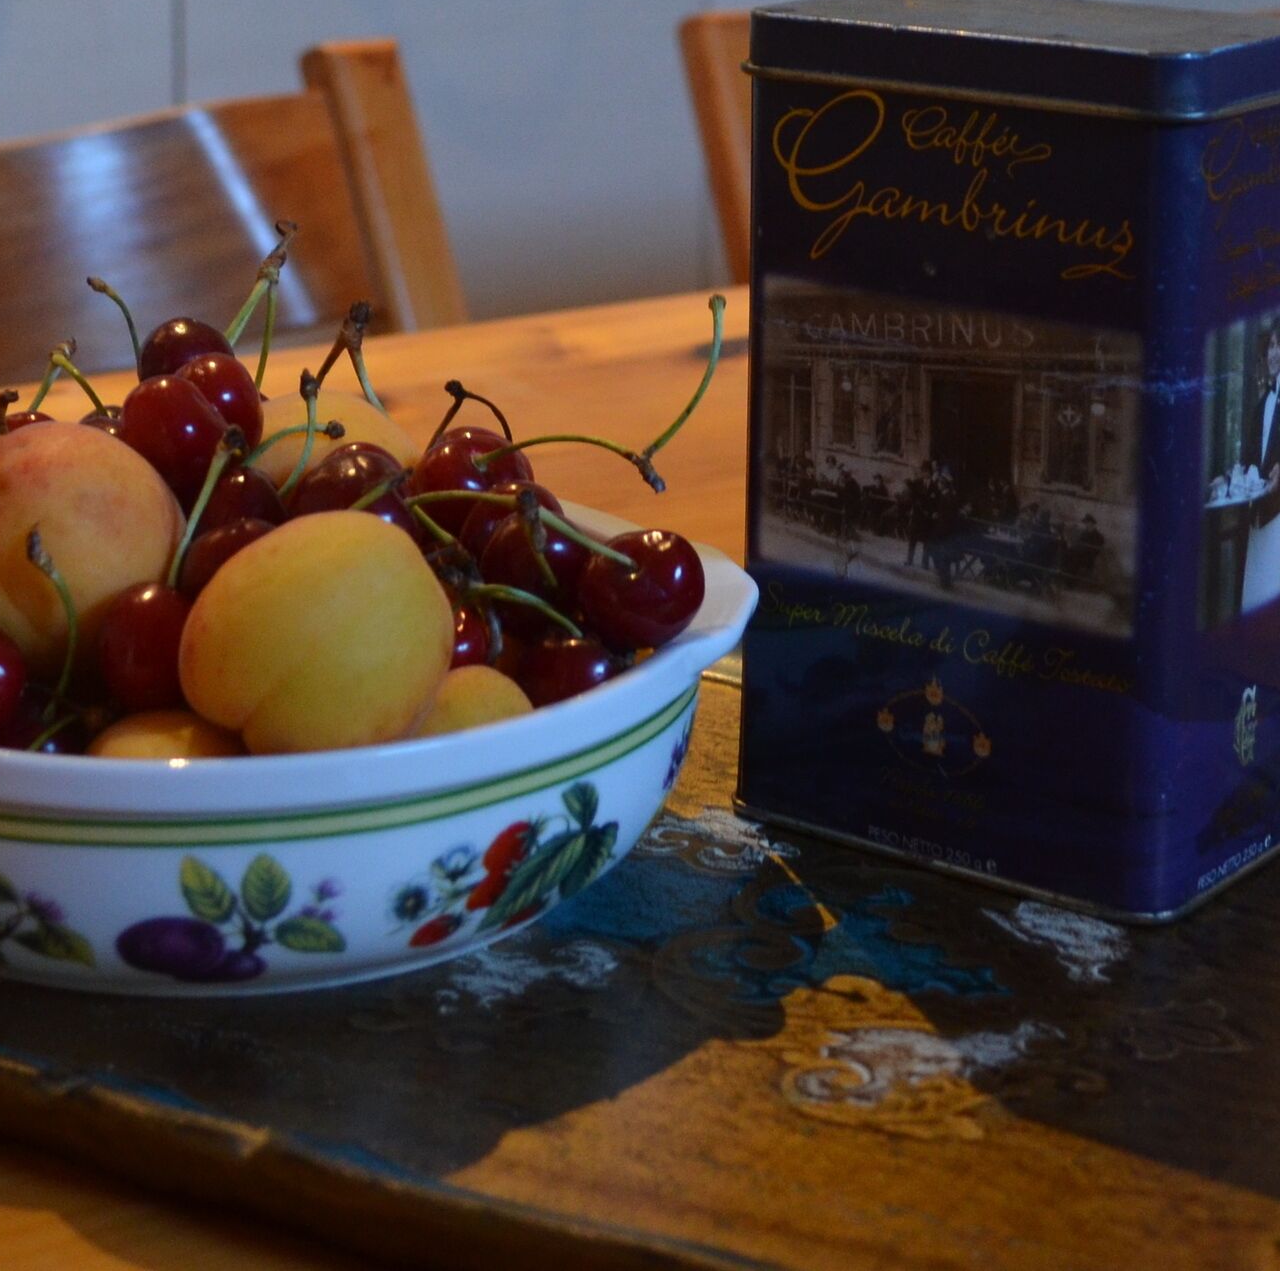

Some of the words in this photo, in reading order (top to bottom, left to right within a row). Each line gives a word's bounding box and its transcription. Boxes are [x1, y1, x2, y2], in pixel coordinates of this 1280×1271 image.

[772, 89, 1136, 279] Gambrinus
[804, 311, 1036, 348] GAMBRINUS
[759, 581, 826, 627] Super
[831, 602, 924, 646] Miscela
[929, 626, 957, 653] di
